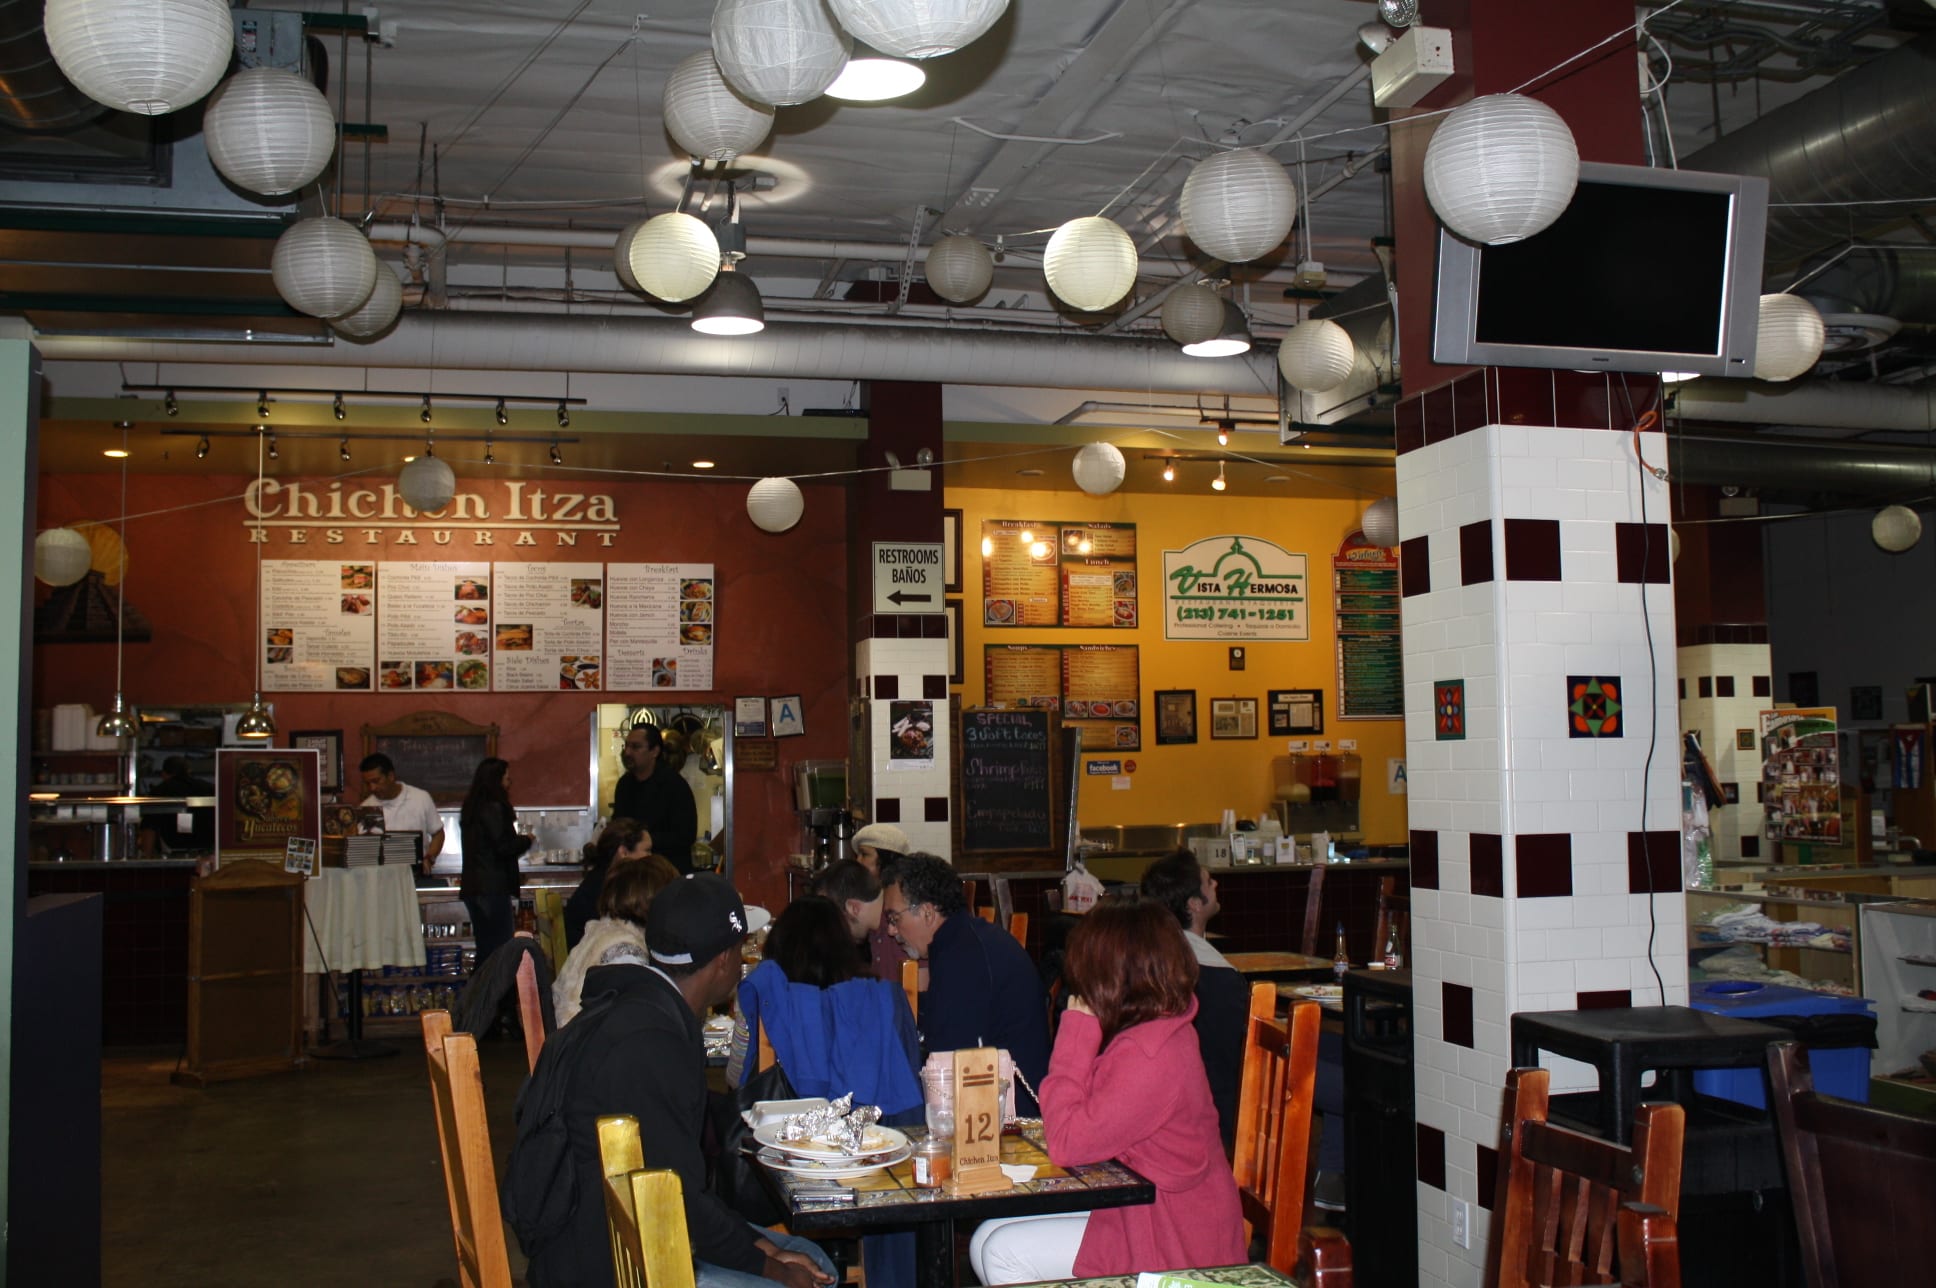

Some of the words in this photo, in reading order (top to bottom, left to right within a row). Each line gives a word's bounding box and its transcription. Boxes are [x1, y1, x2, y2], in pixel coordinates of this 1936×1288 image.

[504, 481, 619, 522] Itza
[249, 528, 616, 547] RESTAURANT
[879, 549, 939, 565] RESTROOMS
[892, 566, 927, 584] BAÑOS
[1177, 606, 1215, 622] (213)
[779, 703, 796, 723] A
[966, 727, 978, 742] 3
[1393, 764, 1408, 783] A
[965, 1113, 994, 1145] 12
